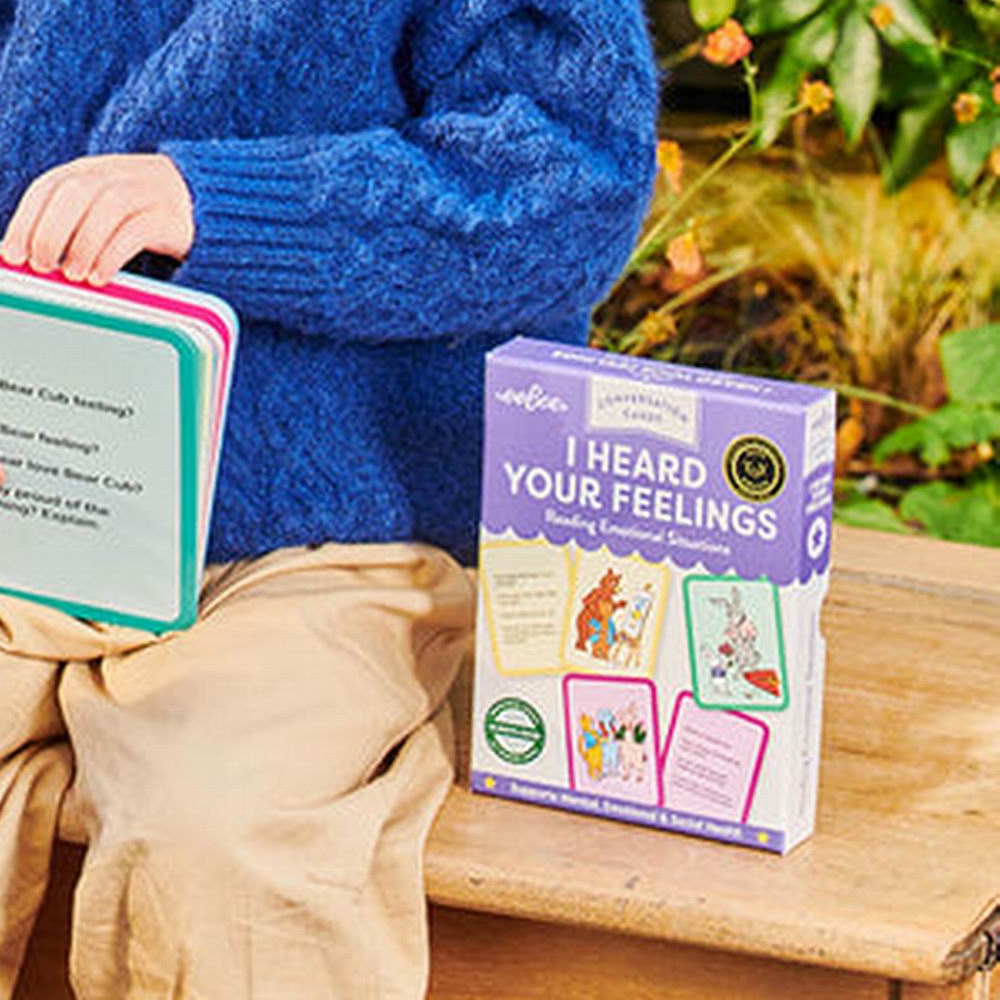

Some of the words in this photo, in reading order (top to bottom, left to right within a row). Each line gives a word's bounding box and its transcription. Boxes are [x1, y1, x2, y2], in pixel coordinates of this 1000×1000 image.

[37, 386, 70, 405] Cub
[72, 393, 135, 419] feeling?
[0, 422, 36, 440] Bear
[38, 431, 101, 456] feeling?
[26, 459, 60, 477] love
[63, 467, 100, 484] Bear
[102, 475, 144, 495] Cub?
[565, 435, 577, 468] I
[587, 440, 707, 489] HEARD
[65, 498, 82, 510] of
[84, 501, 111, 517] the
[503, 462, 602, 510] YOUR
[612, 484, 778, 541] FEELINGS
